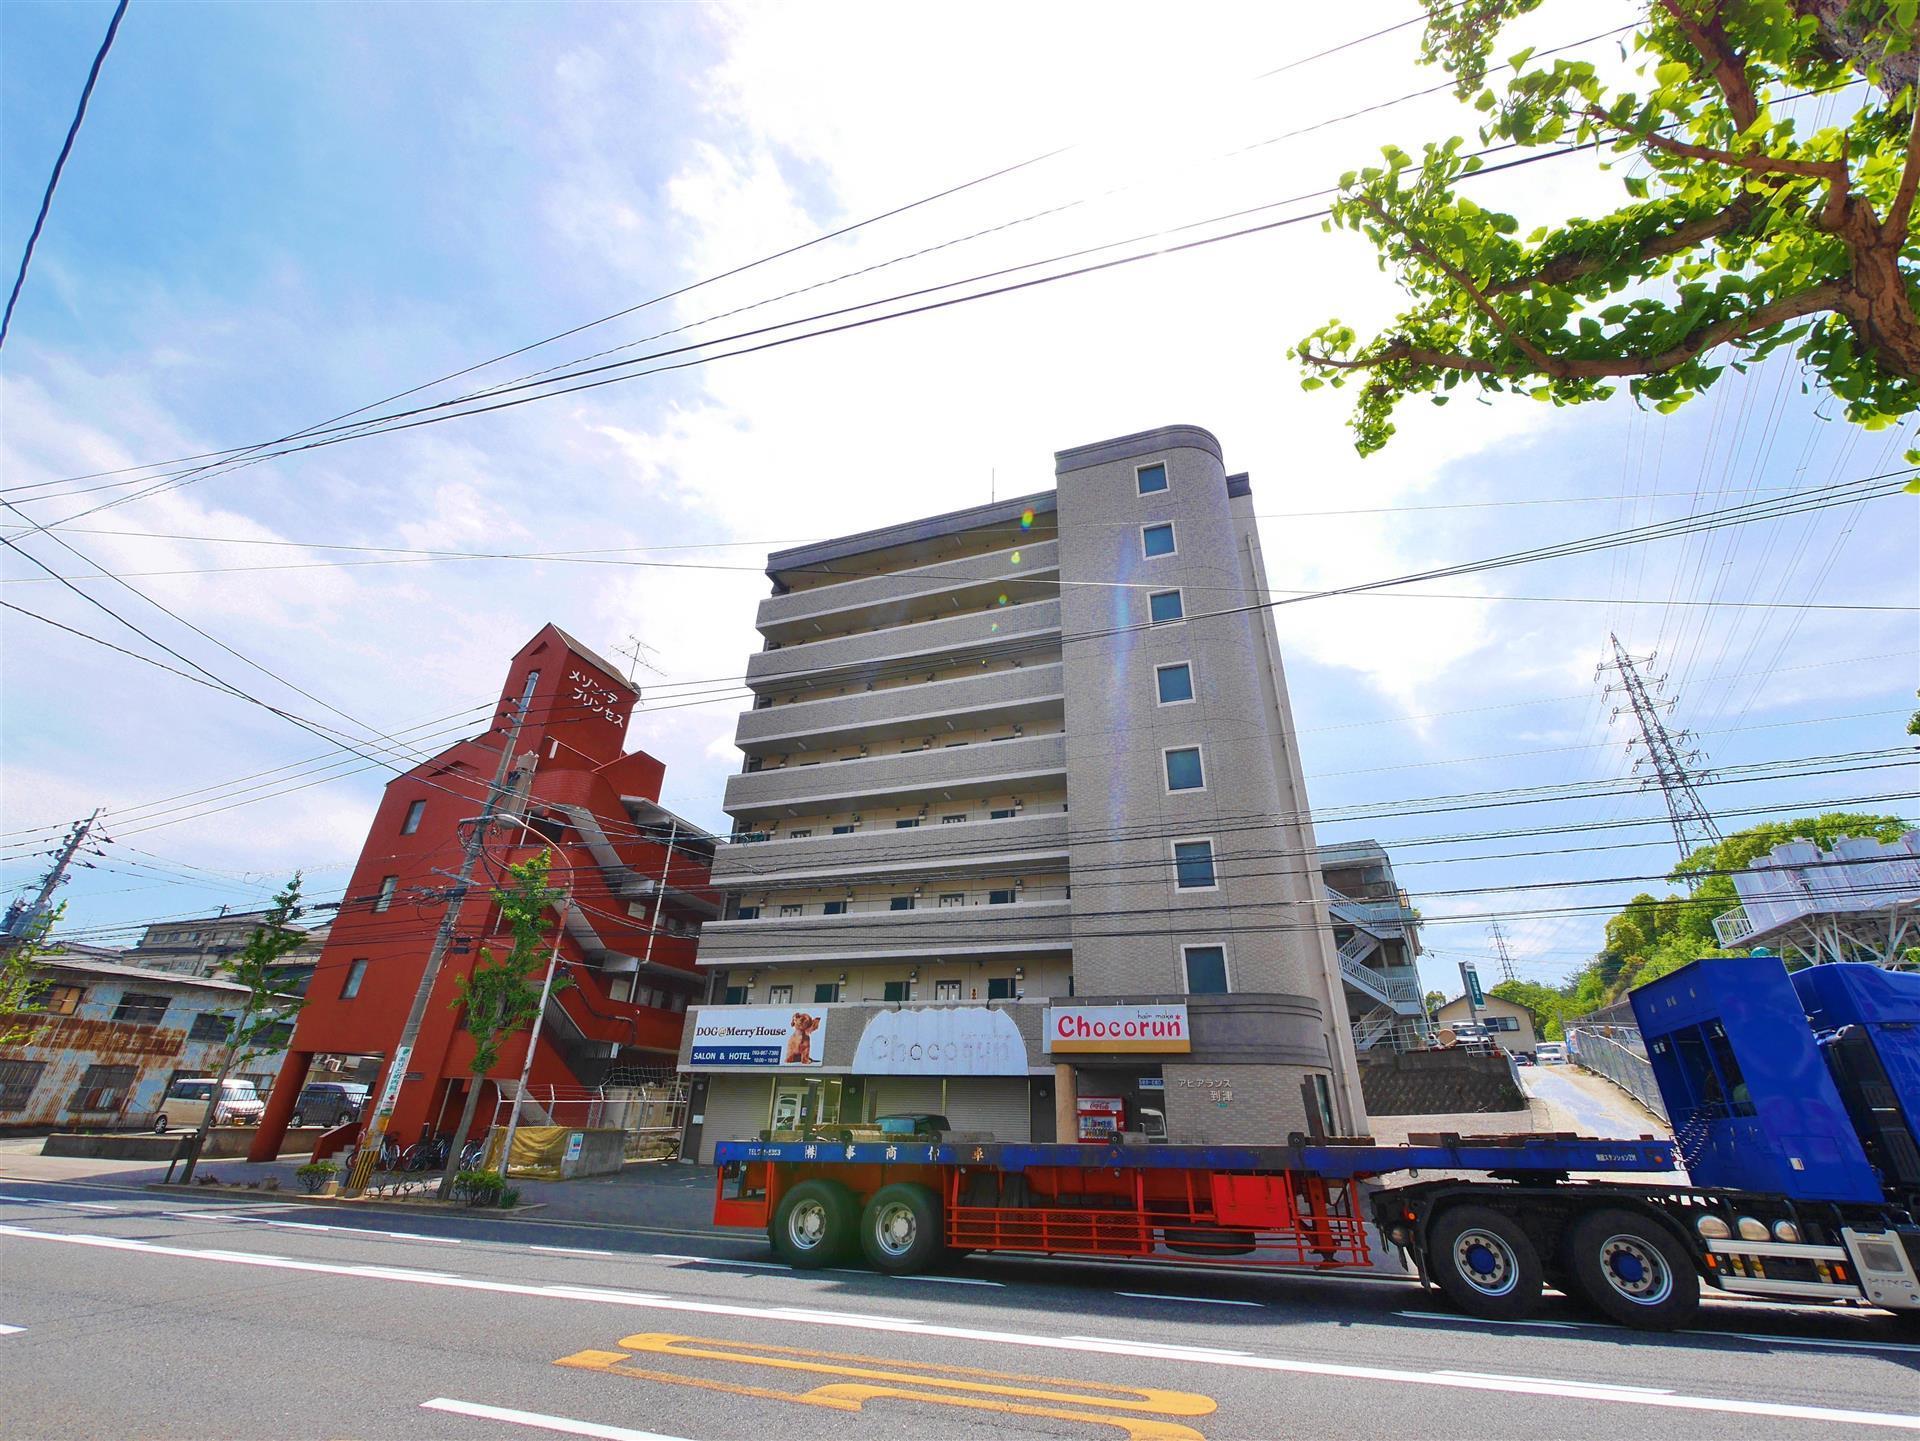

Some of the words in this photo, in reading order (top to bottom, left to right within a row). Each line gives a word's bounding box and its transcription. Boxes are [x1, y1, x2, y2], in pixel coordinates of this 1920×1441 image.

[1137, 1010, 1152, 1020] hair
[1155, 1010, 1174, 1021] make
[1057, 1015, 1181, 1038] Chocorun
[693, 1052, 716, 1060] SALON
[728, 1052, 752, 1060] HOTEL
